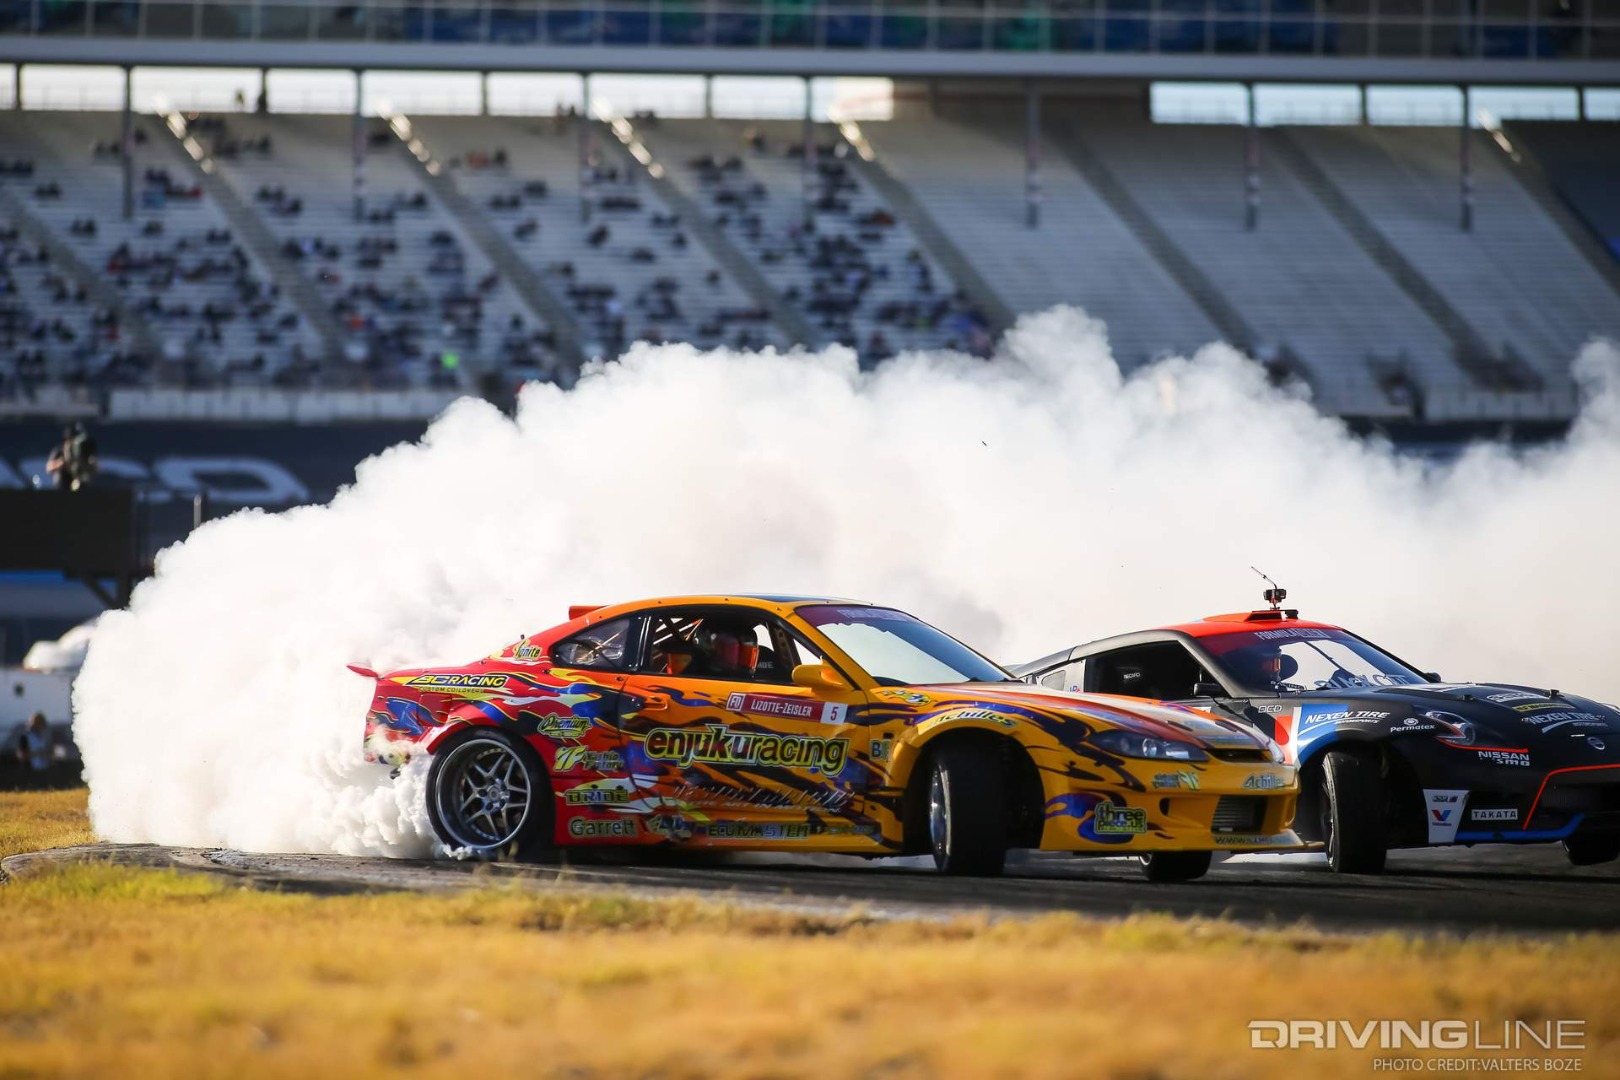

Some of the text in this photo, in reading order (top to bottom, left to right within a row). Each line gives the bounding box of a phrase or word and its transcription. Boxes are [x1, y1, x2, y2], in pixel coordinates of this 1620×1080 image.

[449, 675, 503, 687] RACING
[750, 698, 813, 717] LIZOTTE-ZEISLER
[830, 706, 839, 721] 5
[1305, 710, 1391, 725] NEXEN TIRE
[1529, 711, 1569, 725] NEXEN
[1390, 723, 1436, 733] Permatex
[650, 726, 846, 773] enjukuracing
[1478, 750, 1530, 761] NISSAN
[1099, 803, 1143, 821] three
[1473, 810, 1517, 819] TAKATA
[571, 818, 635, 836] Garrett
